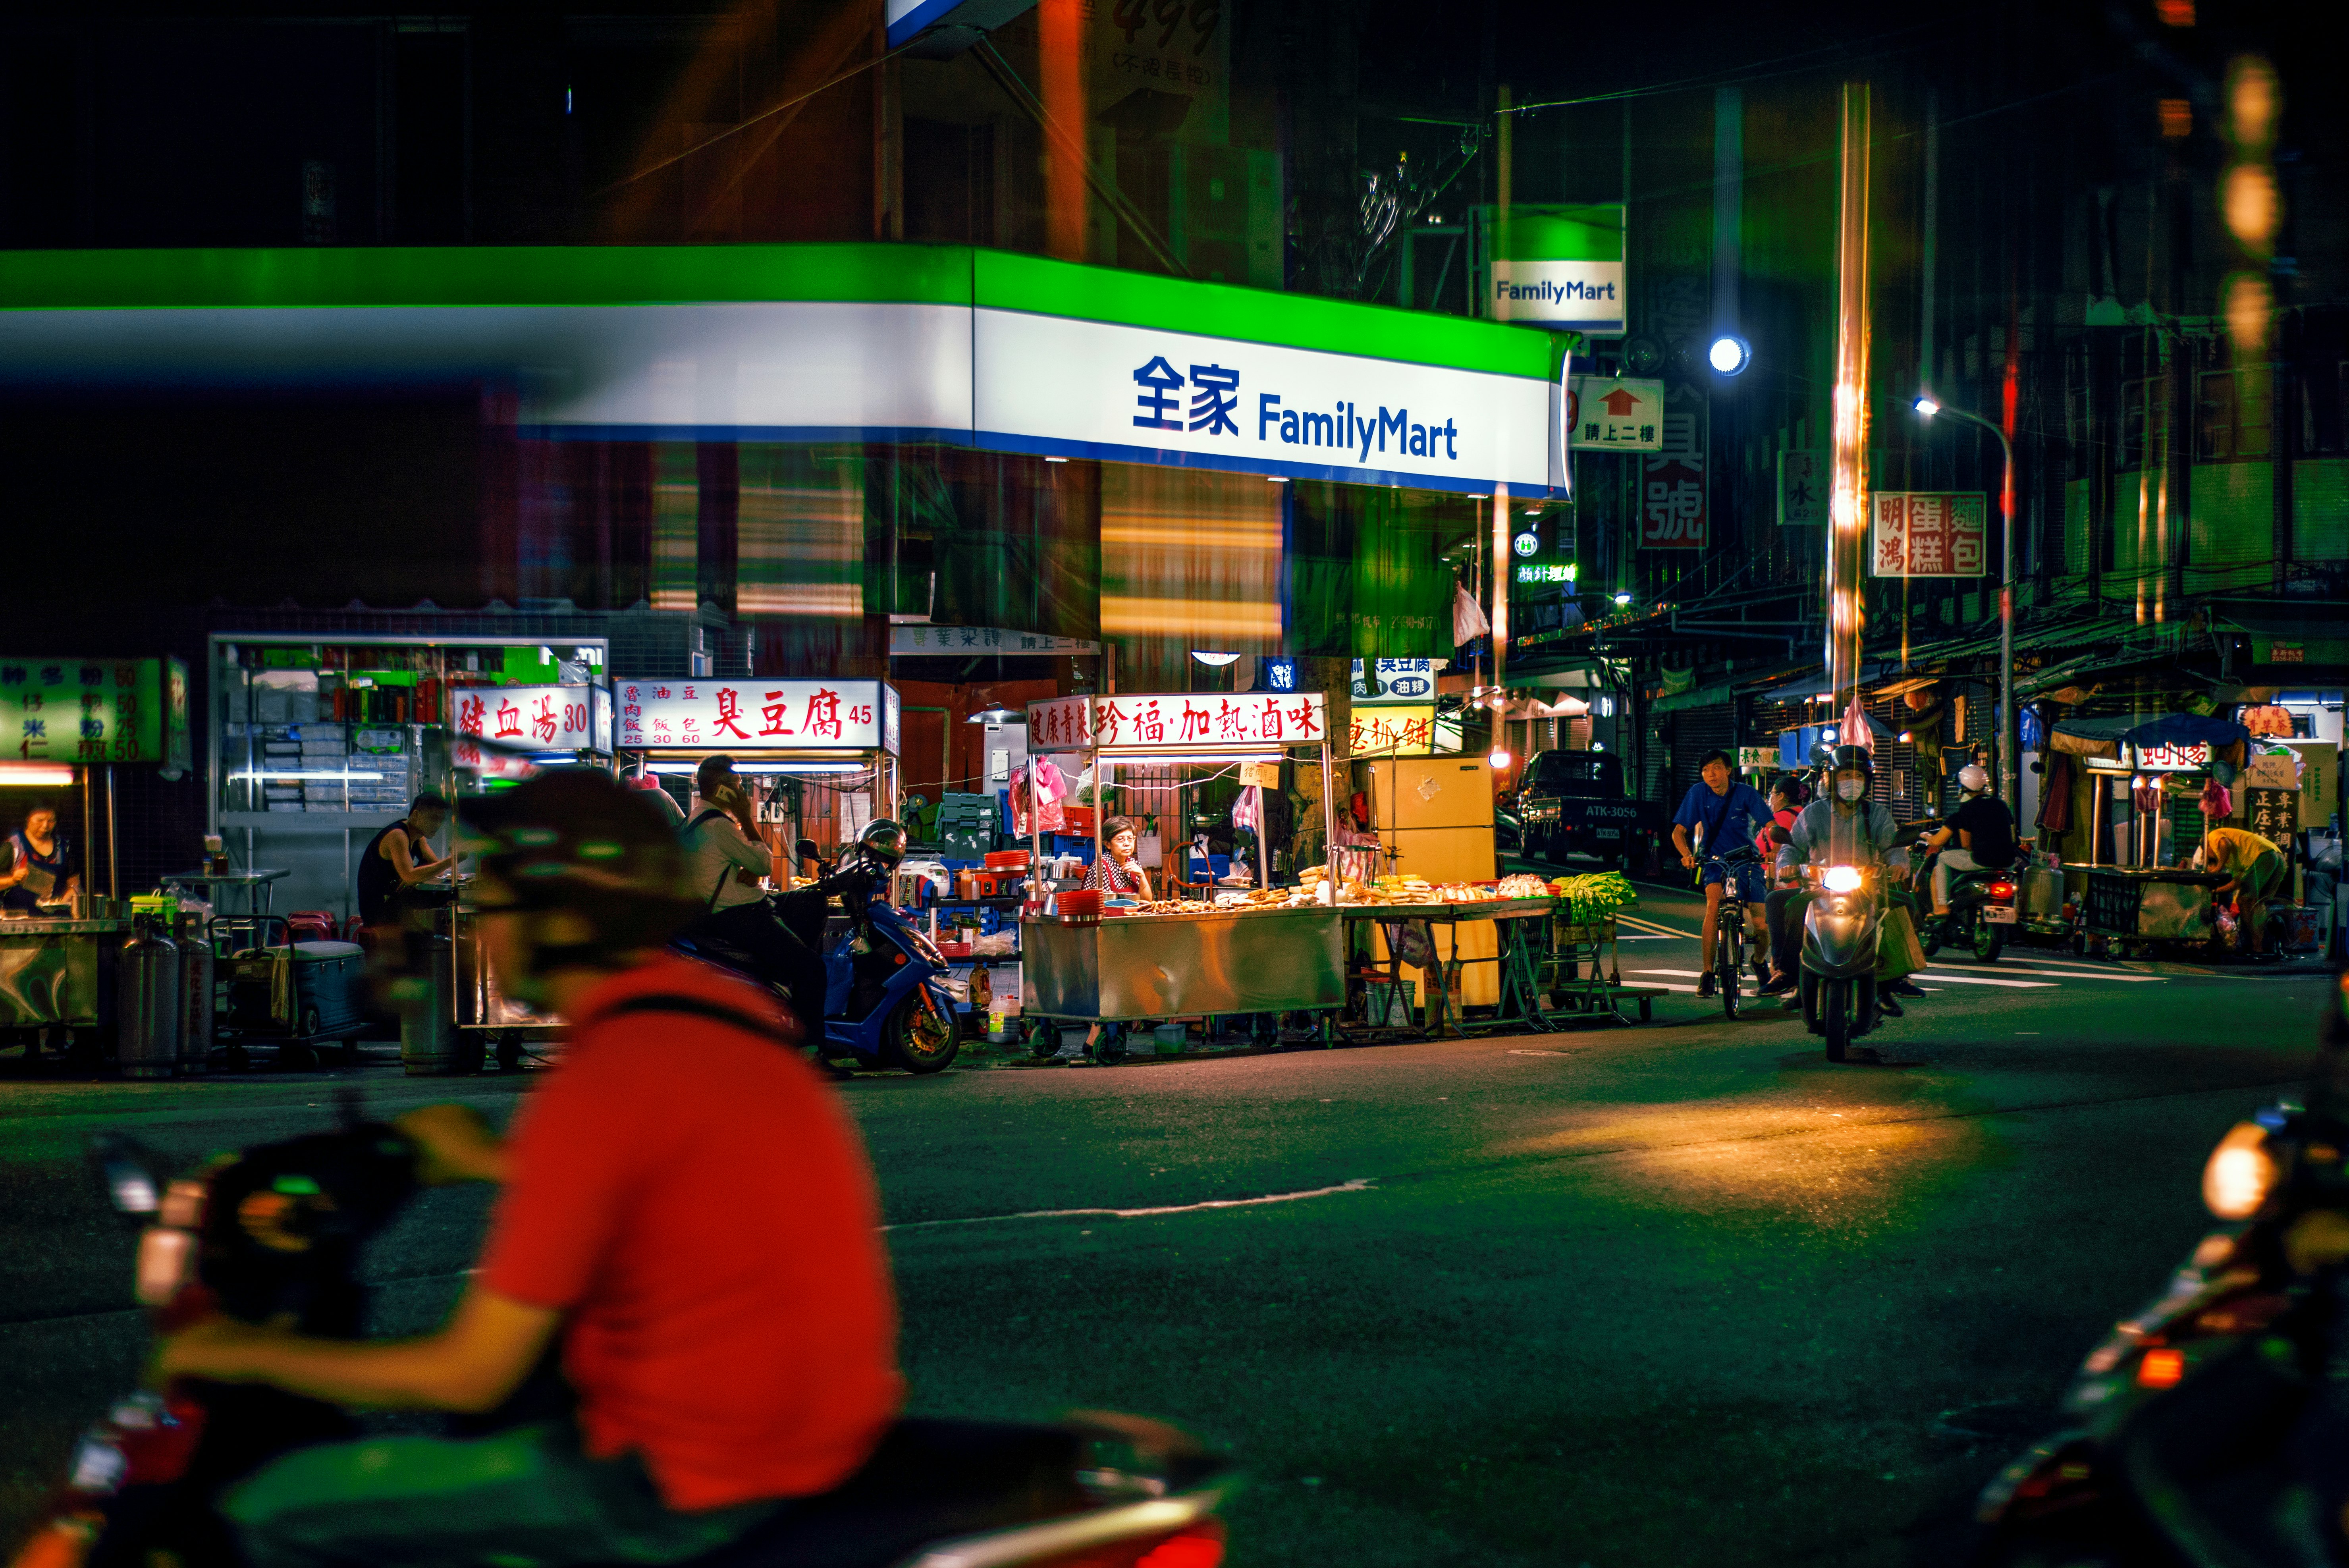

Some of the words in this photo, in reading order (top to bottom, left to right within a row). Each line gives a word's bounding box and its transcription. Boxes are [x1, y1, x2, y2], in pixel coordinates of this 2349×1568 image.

[1113, 0, 1221, 55] 499
[1497, 280, 1615, 305] FamilyMart
[1133, 355, 1240, 437] 全家
[1259, 393, 1457, 463] FamilyMart
[1585, 423, 1655, 442] 請上二樓
[1911, 497, 1943, 573] 蛋糕
[1951, 496, 1982, 573] 麵包
[1396, 680, 1425, 694] 油粿
[459, 694, 558, 744] 豬血湯
[565, 704, 587, 733] 30
[652, 686, 673, 732] 油飯
[712, 687, 844, 740] 臭豆腐
[849, 706, 872, 725] 45
[23, 718, 104, 738] 米粉
[117, 717, 136, 738] 25
[1030, 704, 1090, 745] 健康青菜
[115, 739, 139, 760] 50
[624, 734, 643, 744] 25
[653, 734, 671, 744] 30
[682, 734, 700, 744] 60
[1269, 772, 1277, 781] 30
[1586, 805, 1637, 818] ATK-3056
